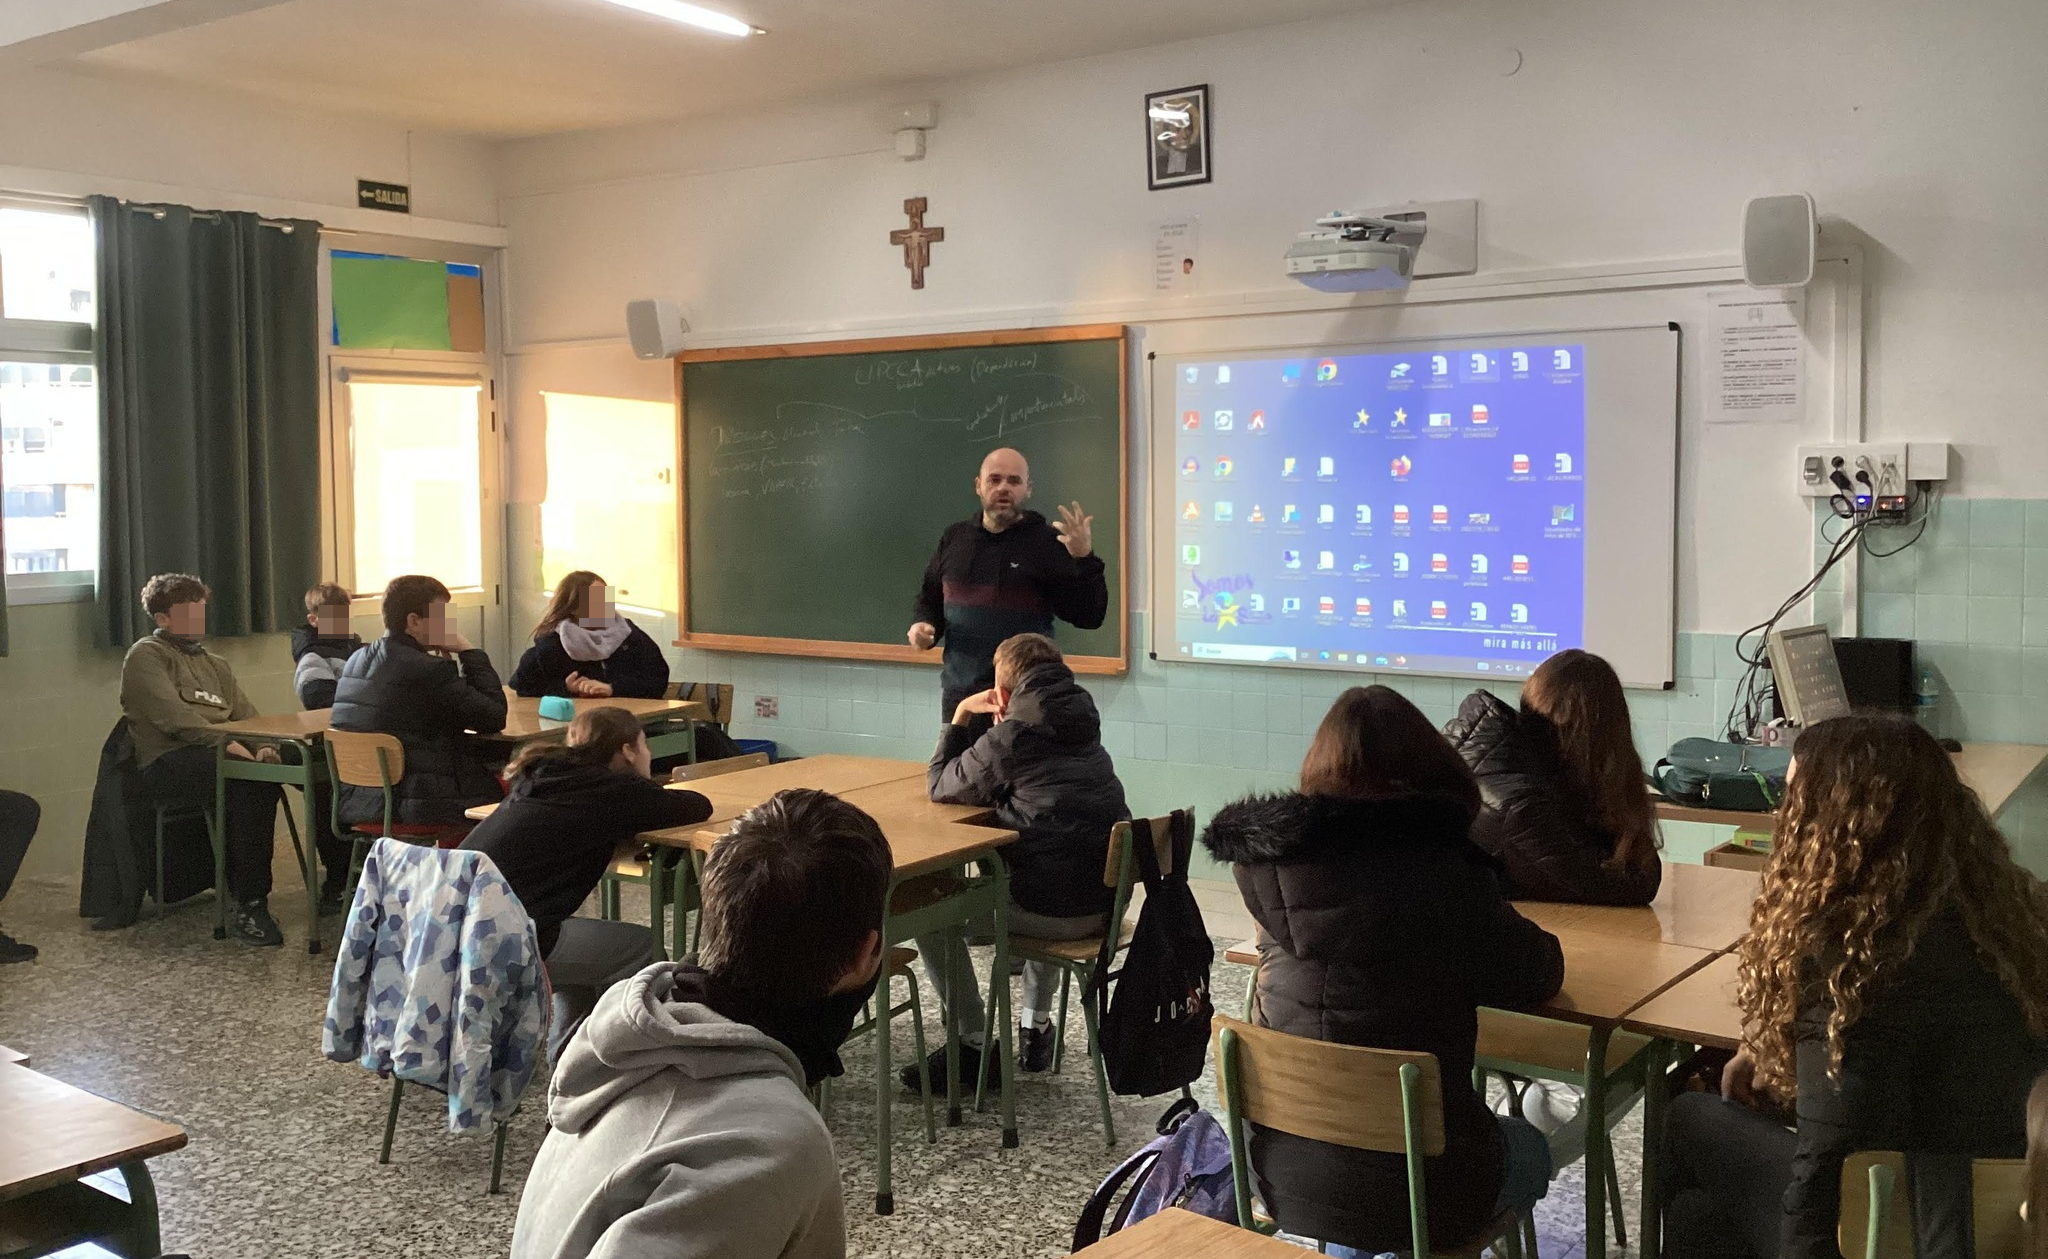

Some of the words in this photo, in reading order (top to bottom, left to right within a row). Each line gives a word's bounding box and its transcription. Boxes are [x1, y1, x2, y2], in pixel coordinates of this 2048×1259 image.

[375, 189, 407, 206] SALIDA
[1483, 635, 1507, 649] mira
[1511, 637, 1532, 650] más
[1536, 638, 1557, 652] allá
[195, 690, 222, 703] FILA
